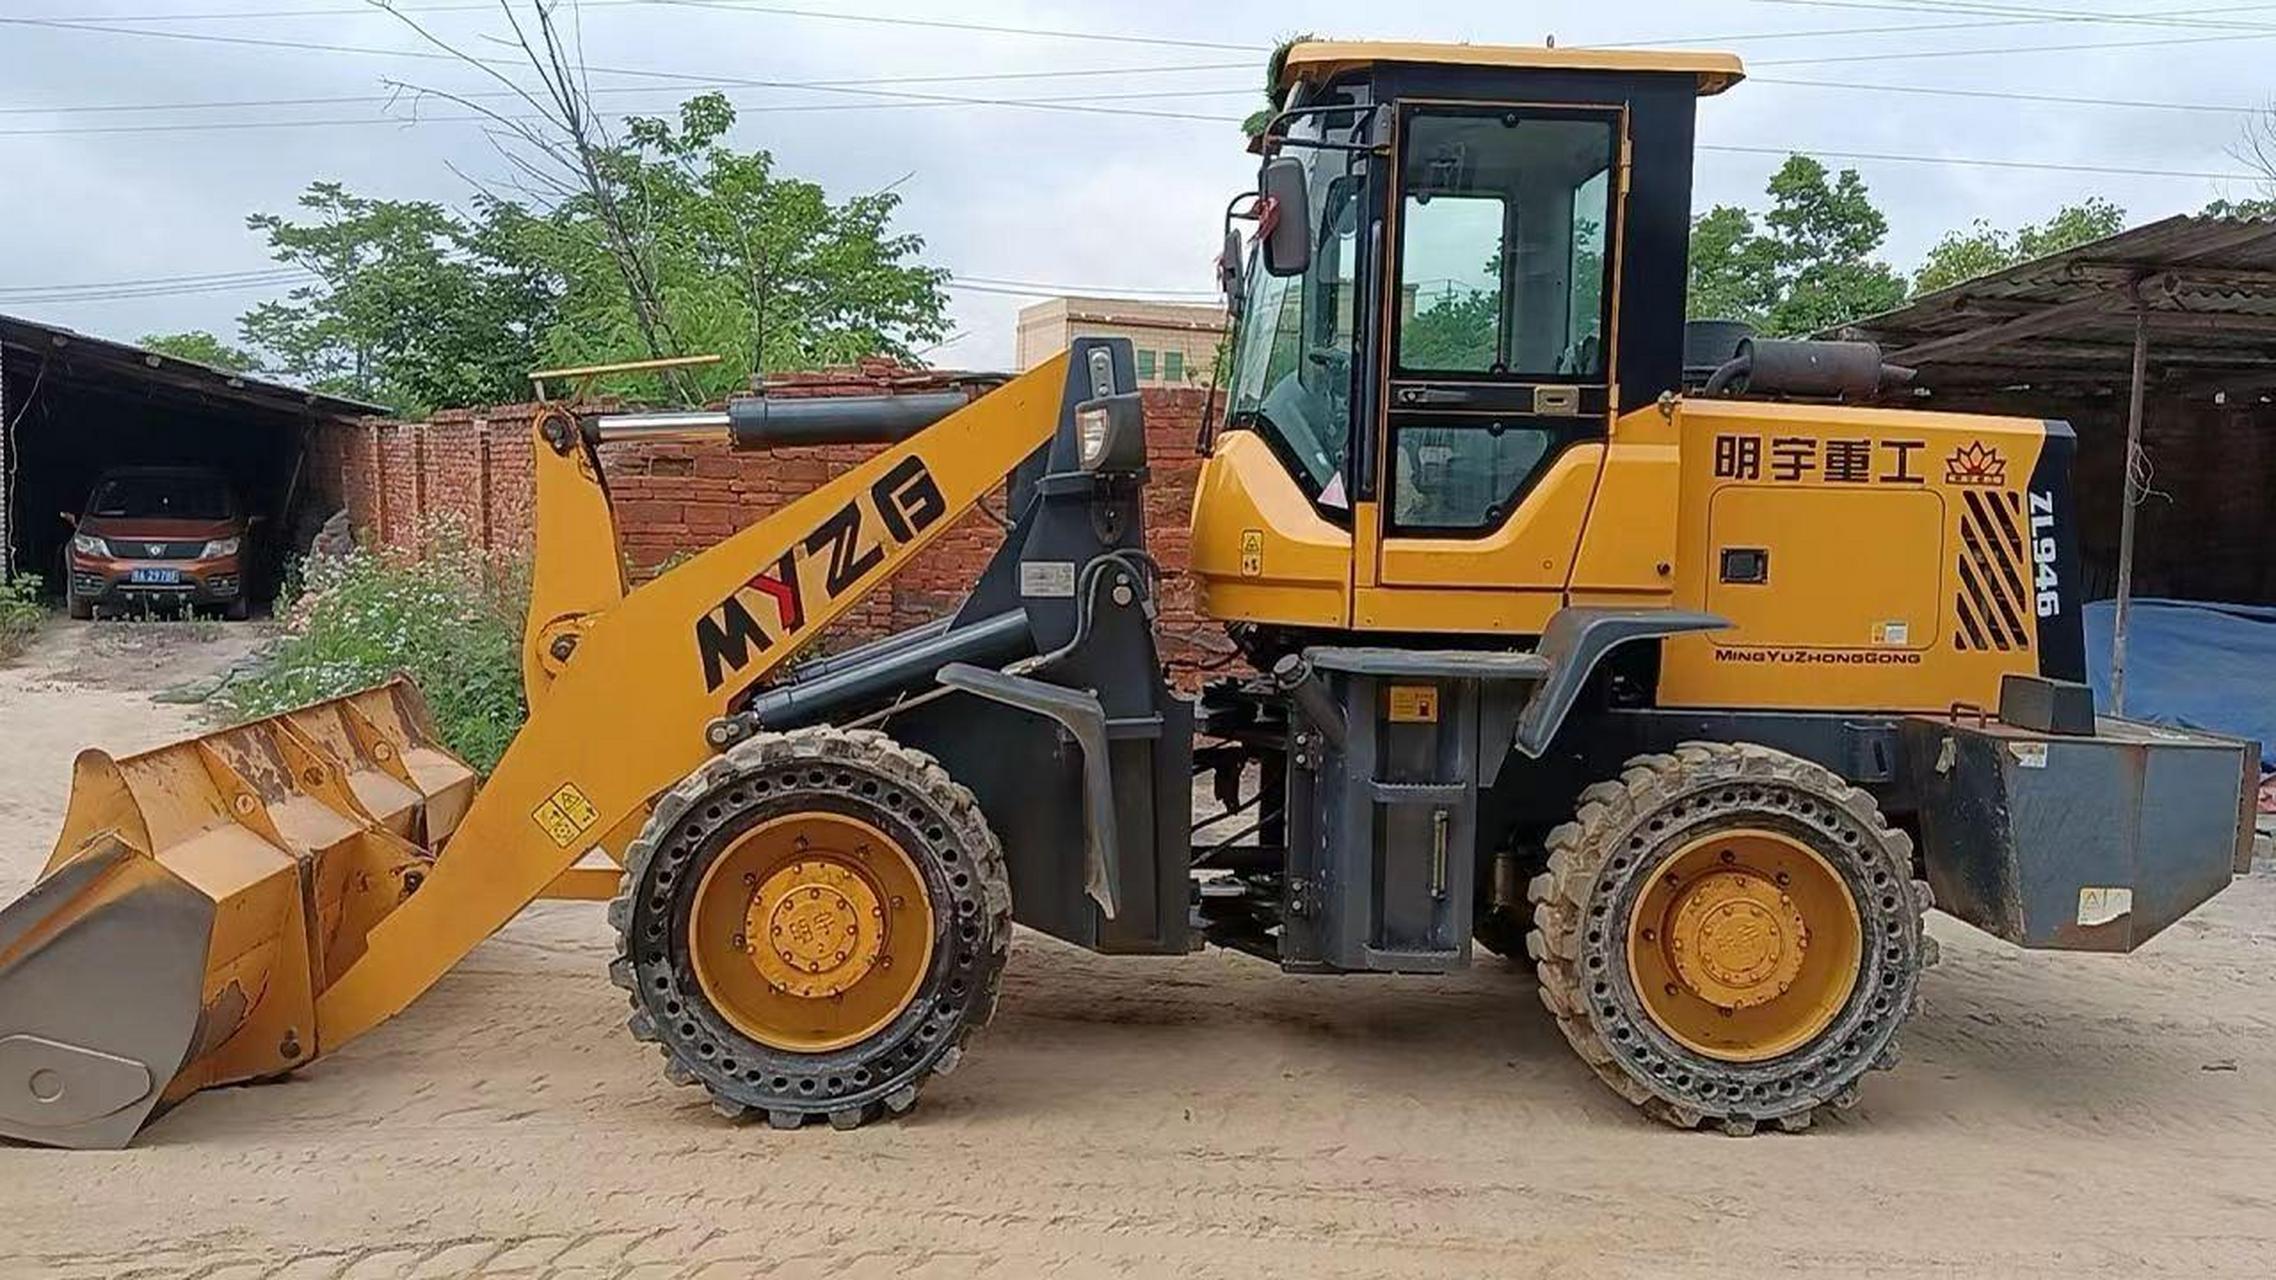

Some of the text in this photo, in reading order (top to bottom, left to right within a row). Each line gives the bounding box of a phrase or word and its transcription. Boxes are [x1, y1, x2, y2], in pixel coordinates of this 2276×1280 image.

[1715, 436, 1926, 483] 明宇重工
[696, 454, 947, 694] MYZG
[2029, 490, 2060, 617] ZL946
